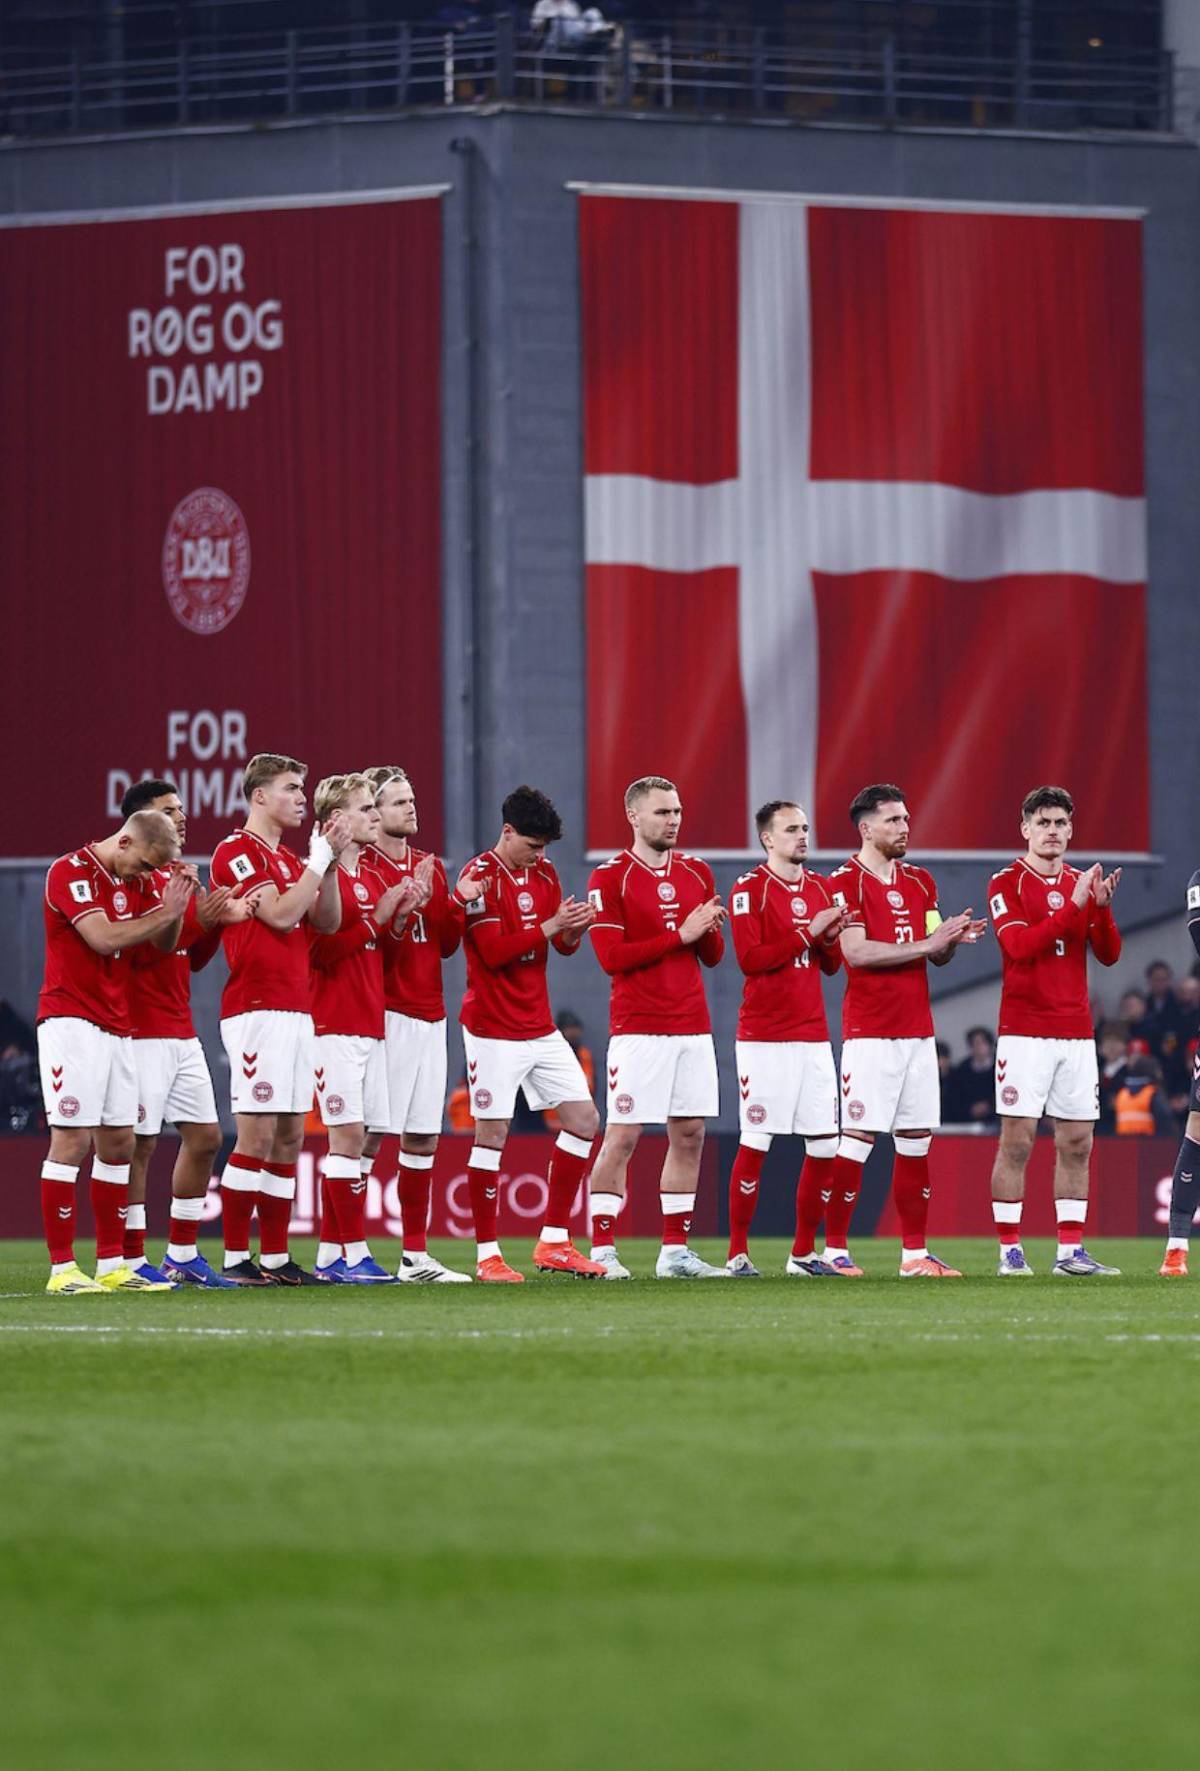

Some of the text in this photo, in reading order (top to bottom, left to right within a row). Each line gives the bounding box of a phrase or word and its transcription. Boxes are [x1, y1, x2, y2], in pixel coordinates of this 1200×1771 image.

[164, 243, 245, 297] FOR
[128, 299, 284, 358] RØG OG
[147, 359, 264, 415] DAMP
[166, 709, 248, 762] FOR
